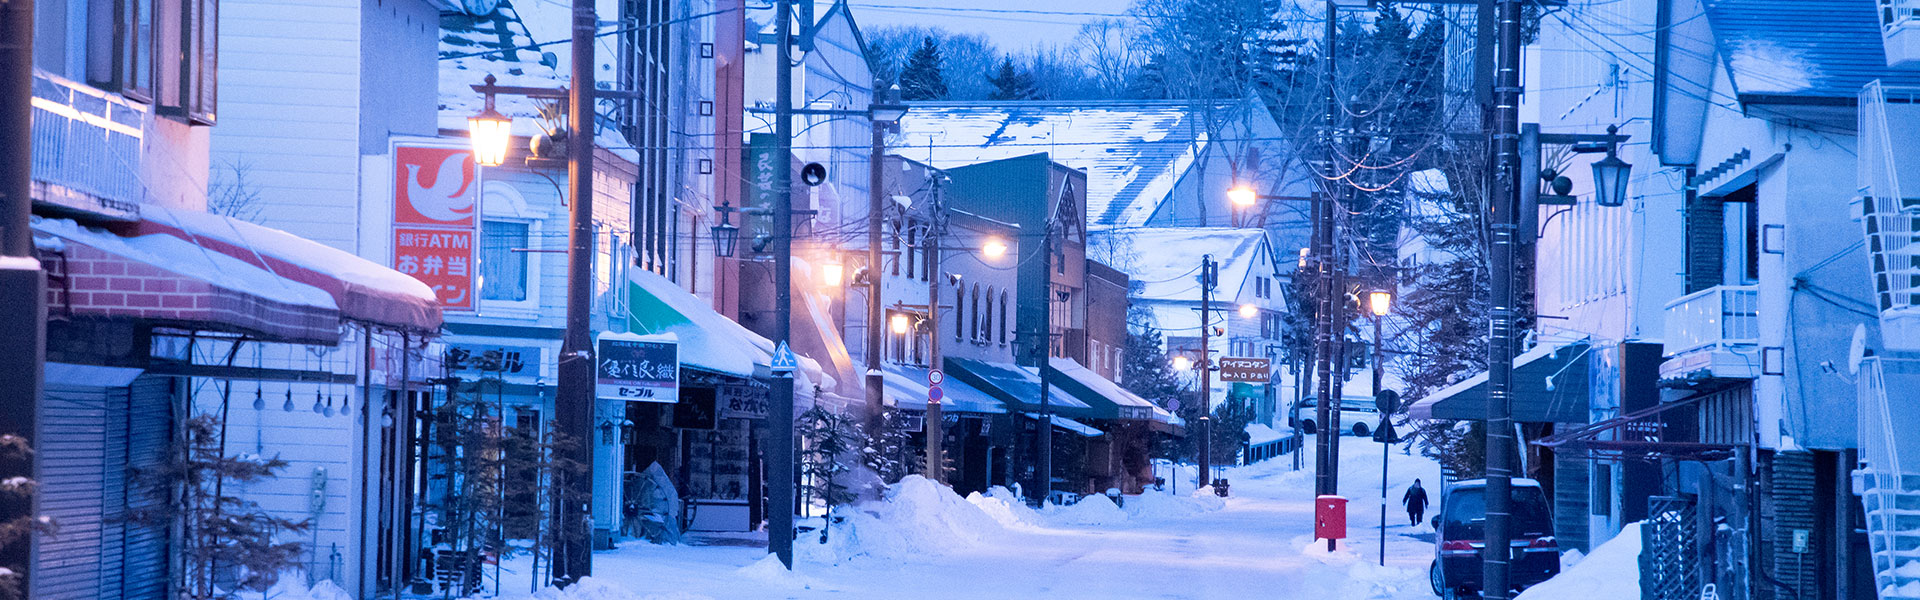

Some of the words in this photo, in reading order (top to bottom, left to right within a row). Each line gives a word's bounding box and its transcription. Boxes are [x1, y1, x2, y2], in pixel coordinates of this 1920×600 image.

[399, 232, 469, 249] 銀行ATM
[398, 254, 468, 277] お弁当
[1222, 360, 1268, 369] アイヌコタン
[618, 387, 655, 398] セーブル
